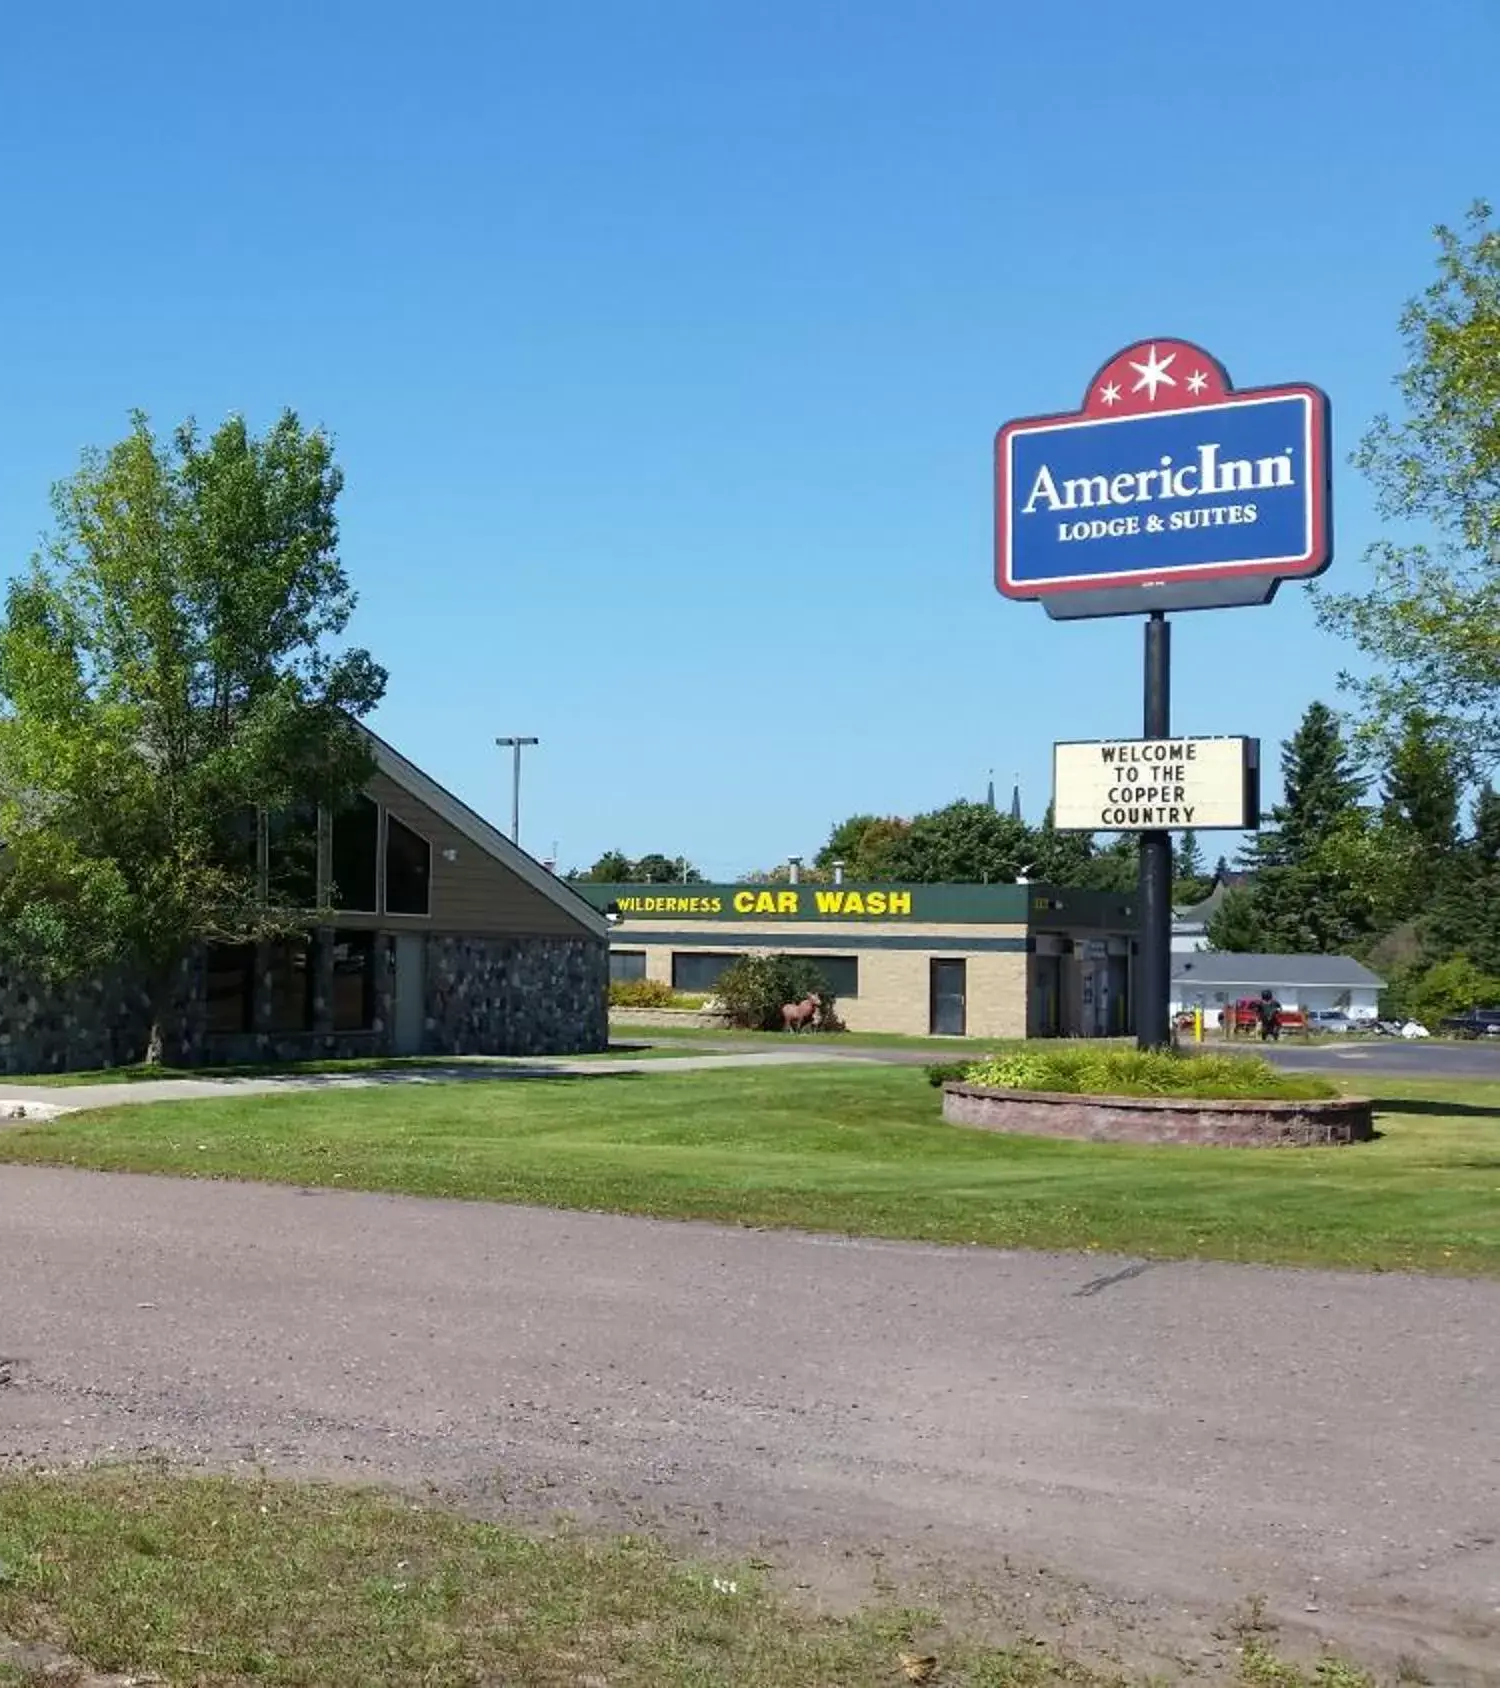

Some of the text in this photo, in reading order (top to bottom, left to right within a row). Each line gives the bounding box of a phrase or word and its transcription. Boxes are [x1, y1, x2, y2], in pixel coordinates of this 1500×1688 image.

[1022, 443, 1295, 513] AmericInn
[1058, 504, 1258, 541] LODGE & SUITES
[1101, 744, 1197, 763] WELCOME
[1114, 765, 1185, 783] TO THE
[1107, 786, 1186, 804] COPPER
[1101, 807, 1195, 825] COUNTRY
[616, 891, 912, 915] WILDERNESS CAR WASH
